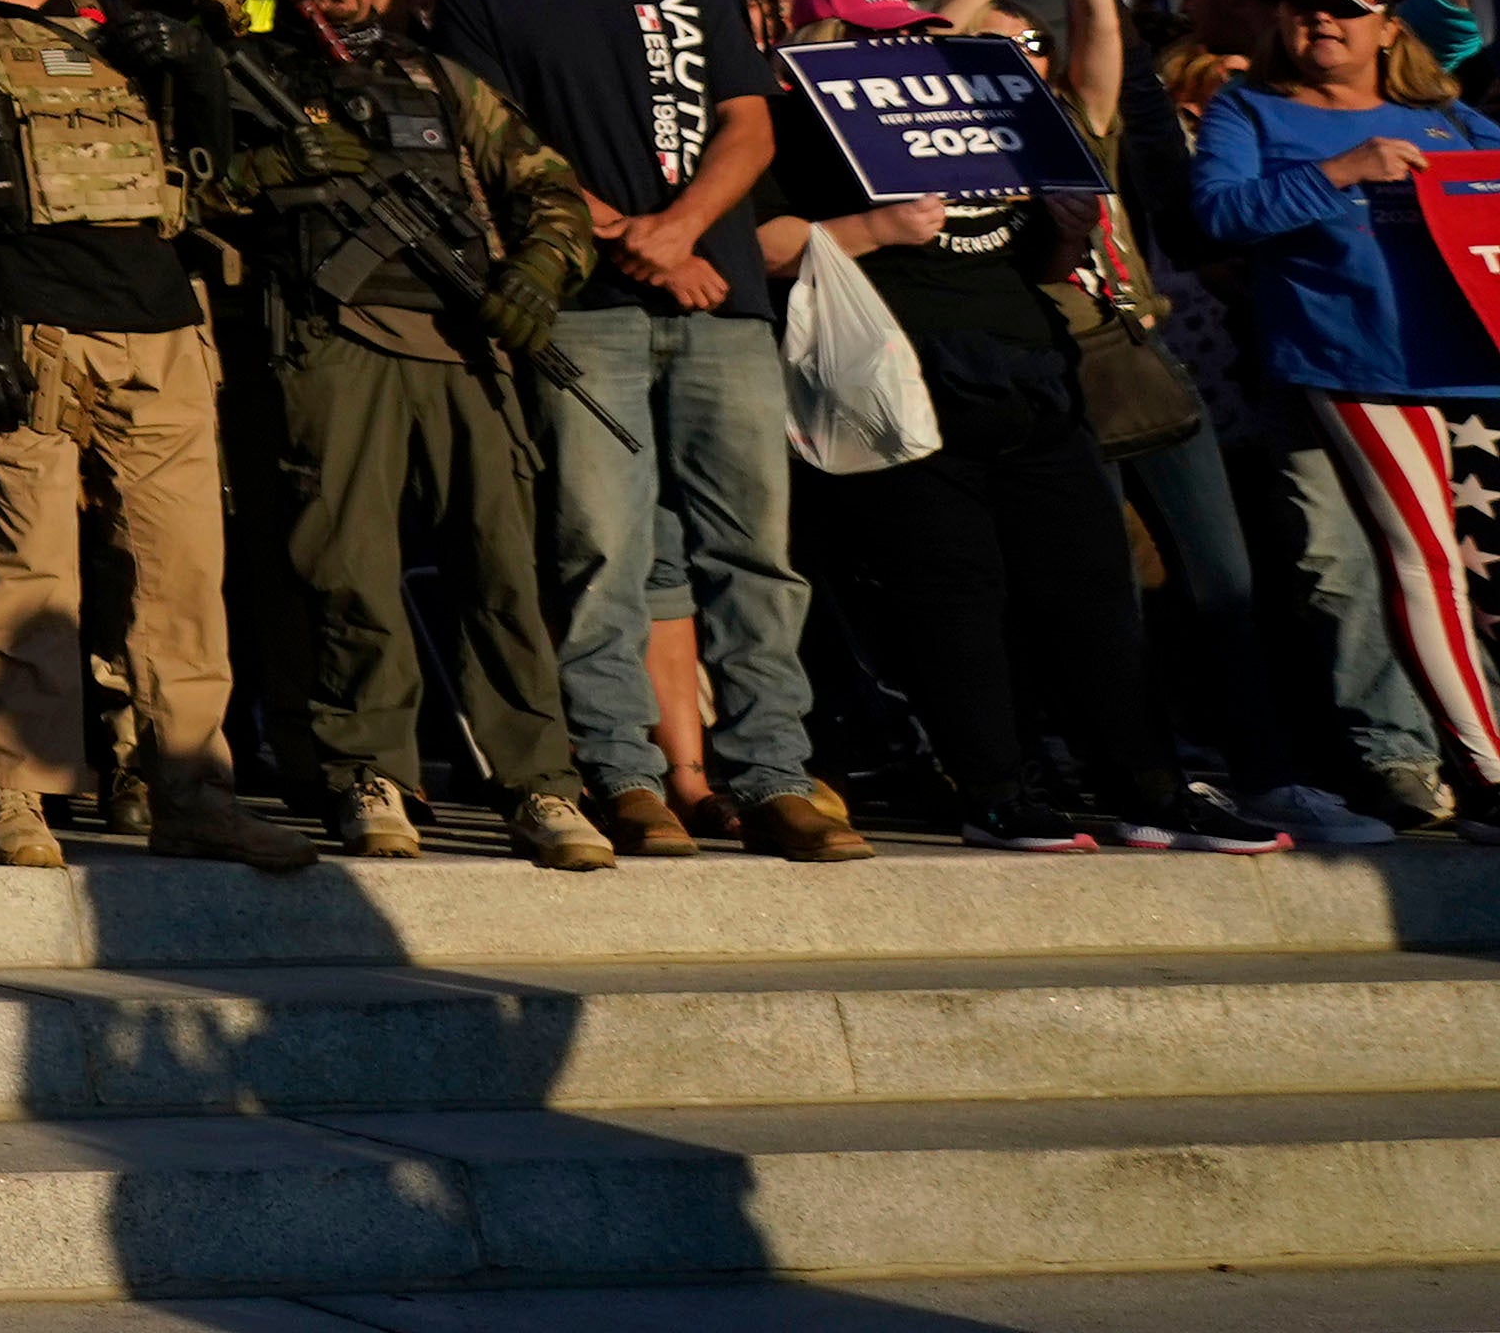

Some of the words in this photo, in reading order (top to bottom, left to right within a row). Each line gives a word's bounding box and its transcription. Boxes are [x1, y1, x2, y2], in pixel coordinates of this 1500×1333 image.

[643, 33, 675, 85] EST.
[816, 73, 1034, 111] TRUMP
[652, 93, 680, 152] 1983
[902, 126, 1025, 158] 2020
